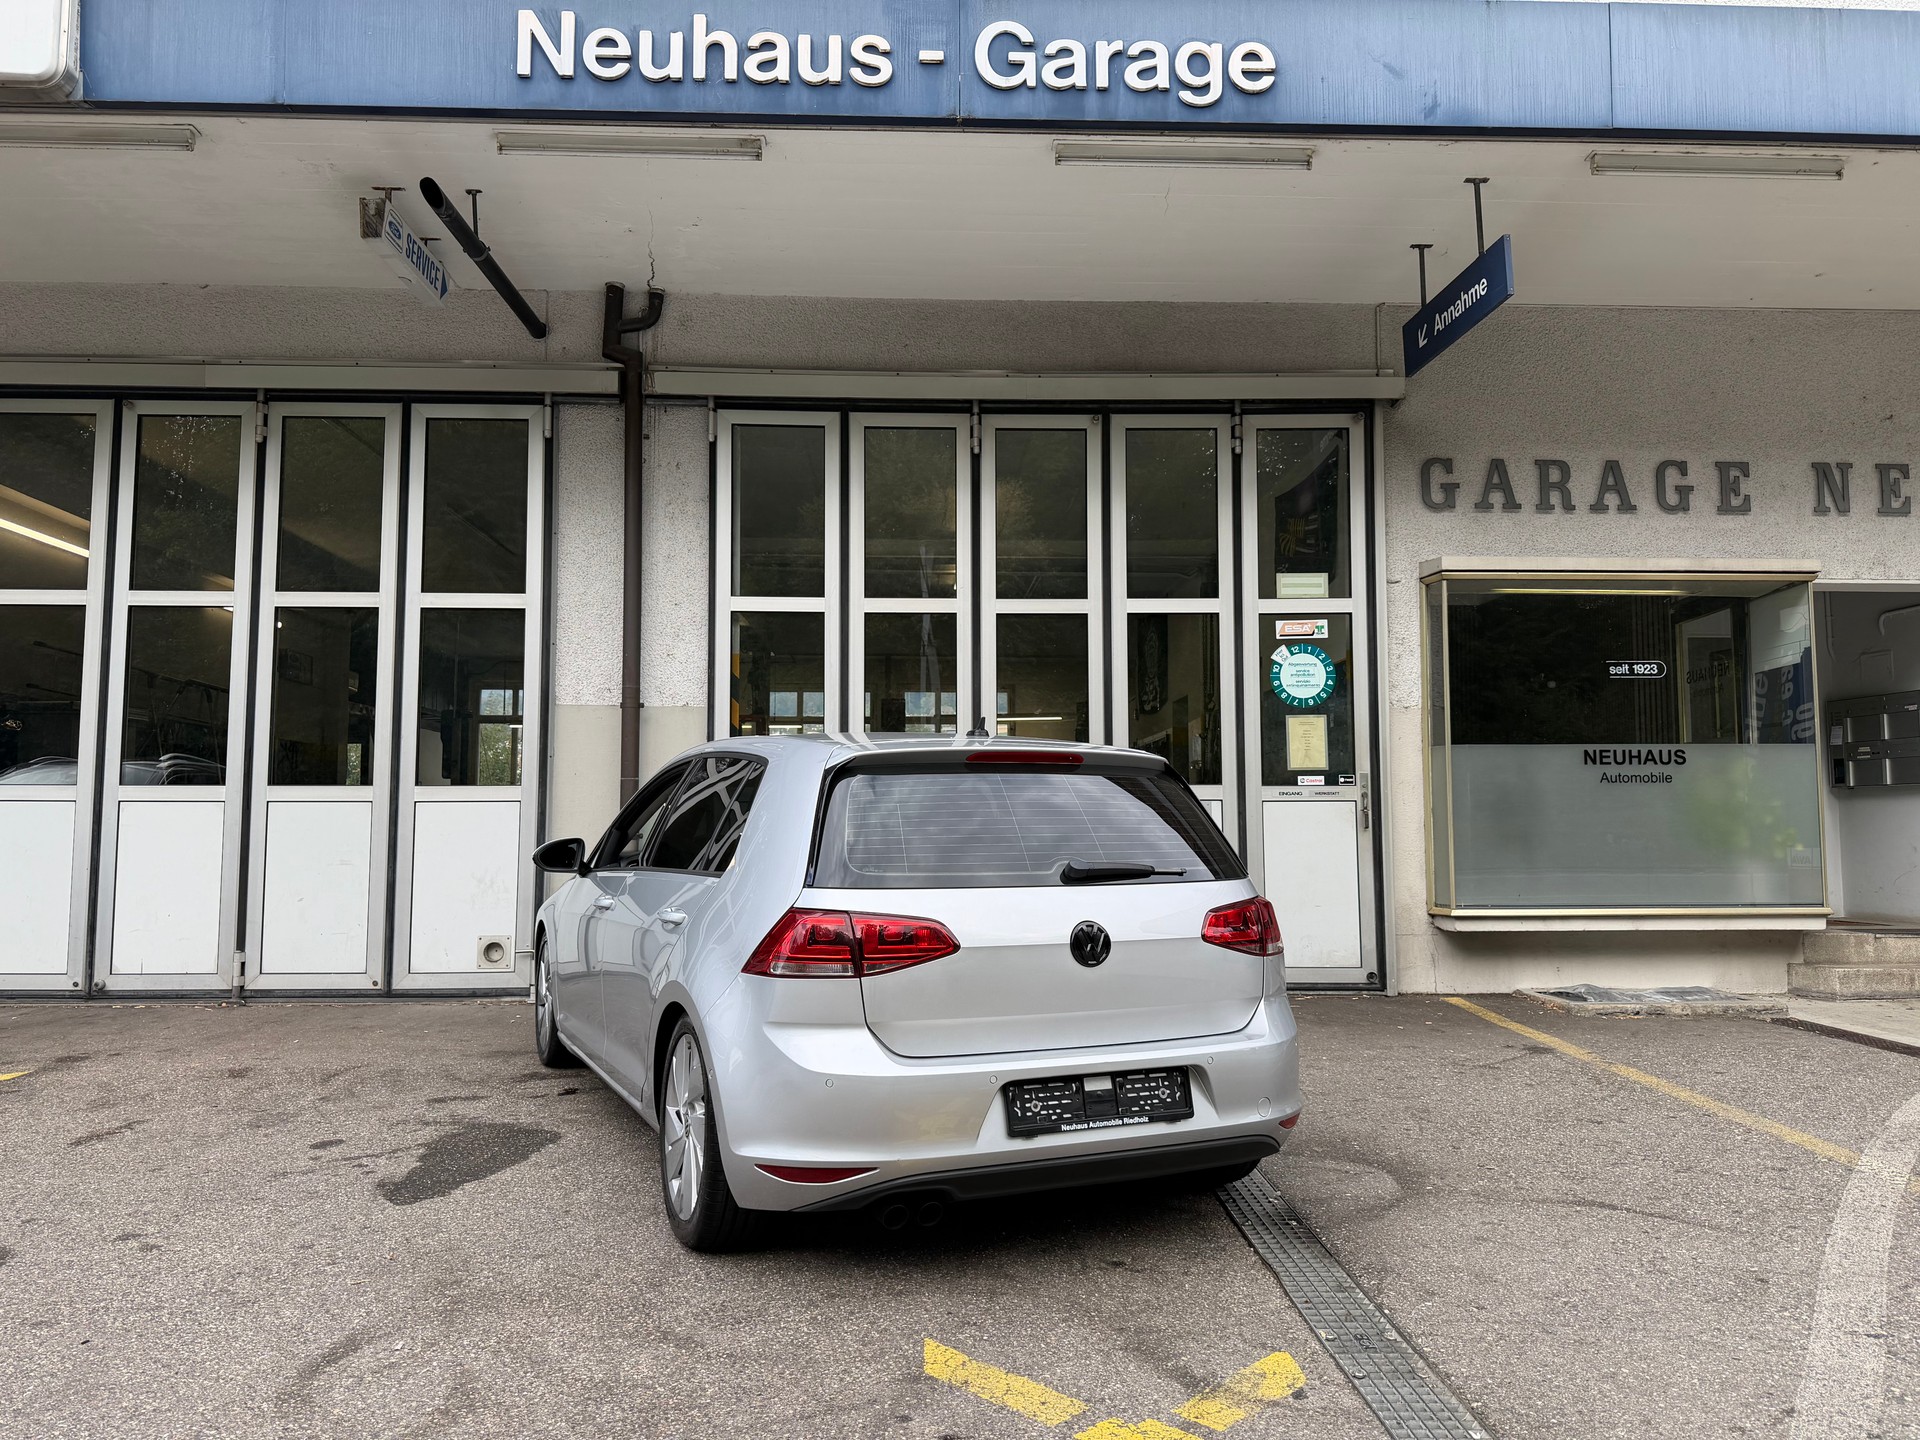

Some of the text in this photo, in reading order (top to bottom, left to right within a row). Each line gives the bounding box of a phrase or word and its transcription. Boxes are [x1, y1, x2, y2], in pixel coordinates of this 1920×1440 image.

[516, 9, 893, 87] Neuhaus
[974, 20, 1277, 107] Garage
[405, 232, 441, 292] SERVICE
[1433, 277, 1488, 336] Annahme
[1419, 457, 1912, 515] GARAGE NE
[1284, 624, 1311, 633] ESA
[1272, 664, 1280, 673] 10
[1609, 664, 1658, 674] seit 1923
[1583, 749, 1687, 765] NEUHAUS
[1600, 772, 1673, 783] Automobile
[1061, 1116, 1149, 1131] Neuhaus Automobile Riedholz
